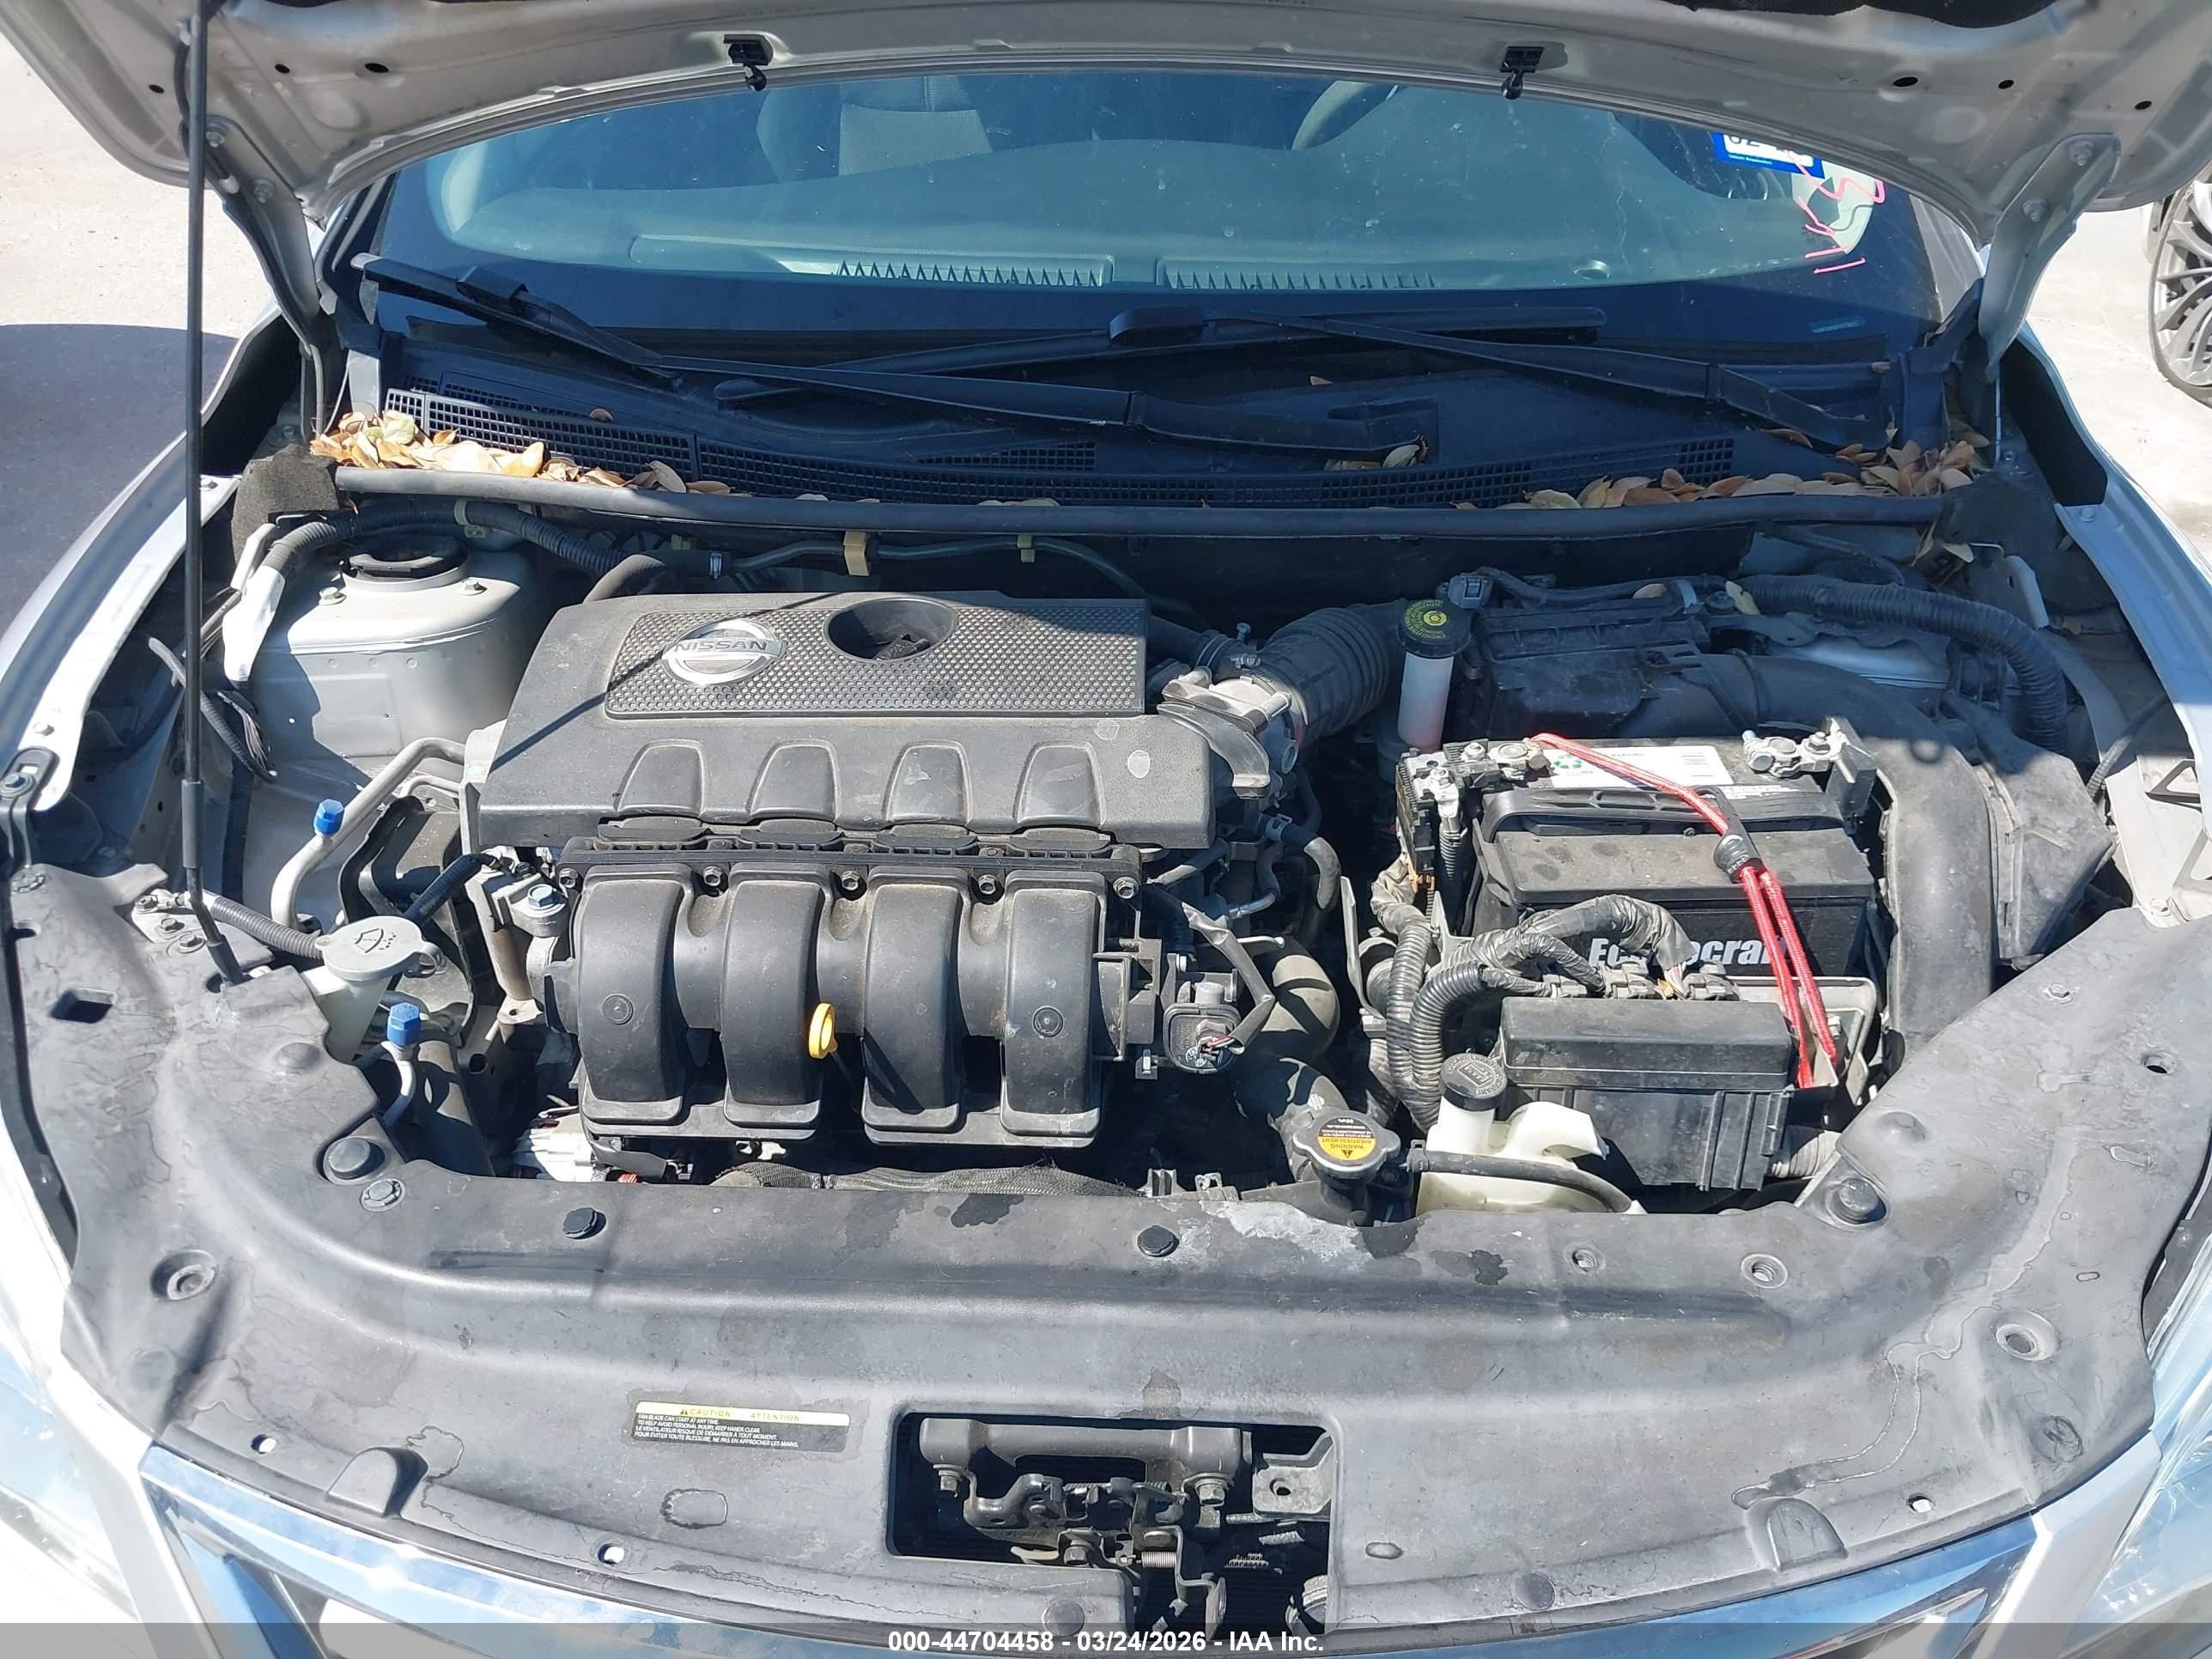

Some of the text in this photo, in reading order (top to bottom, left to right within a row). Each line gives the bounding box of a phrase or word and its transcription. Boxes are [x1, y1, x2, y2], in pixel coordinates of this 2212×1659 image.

[674, 640, 768, 653] NISSAN
[690, 1409, 799, 1421] CAUTION ATTENTION
